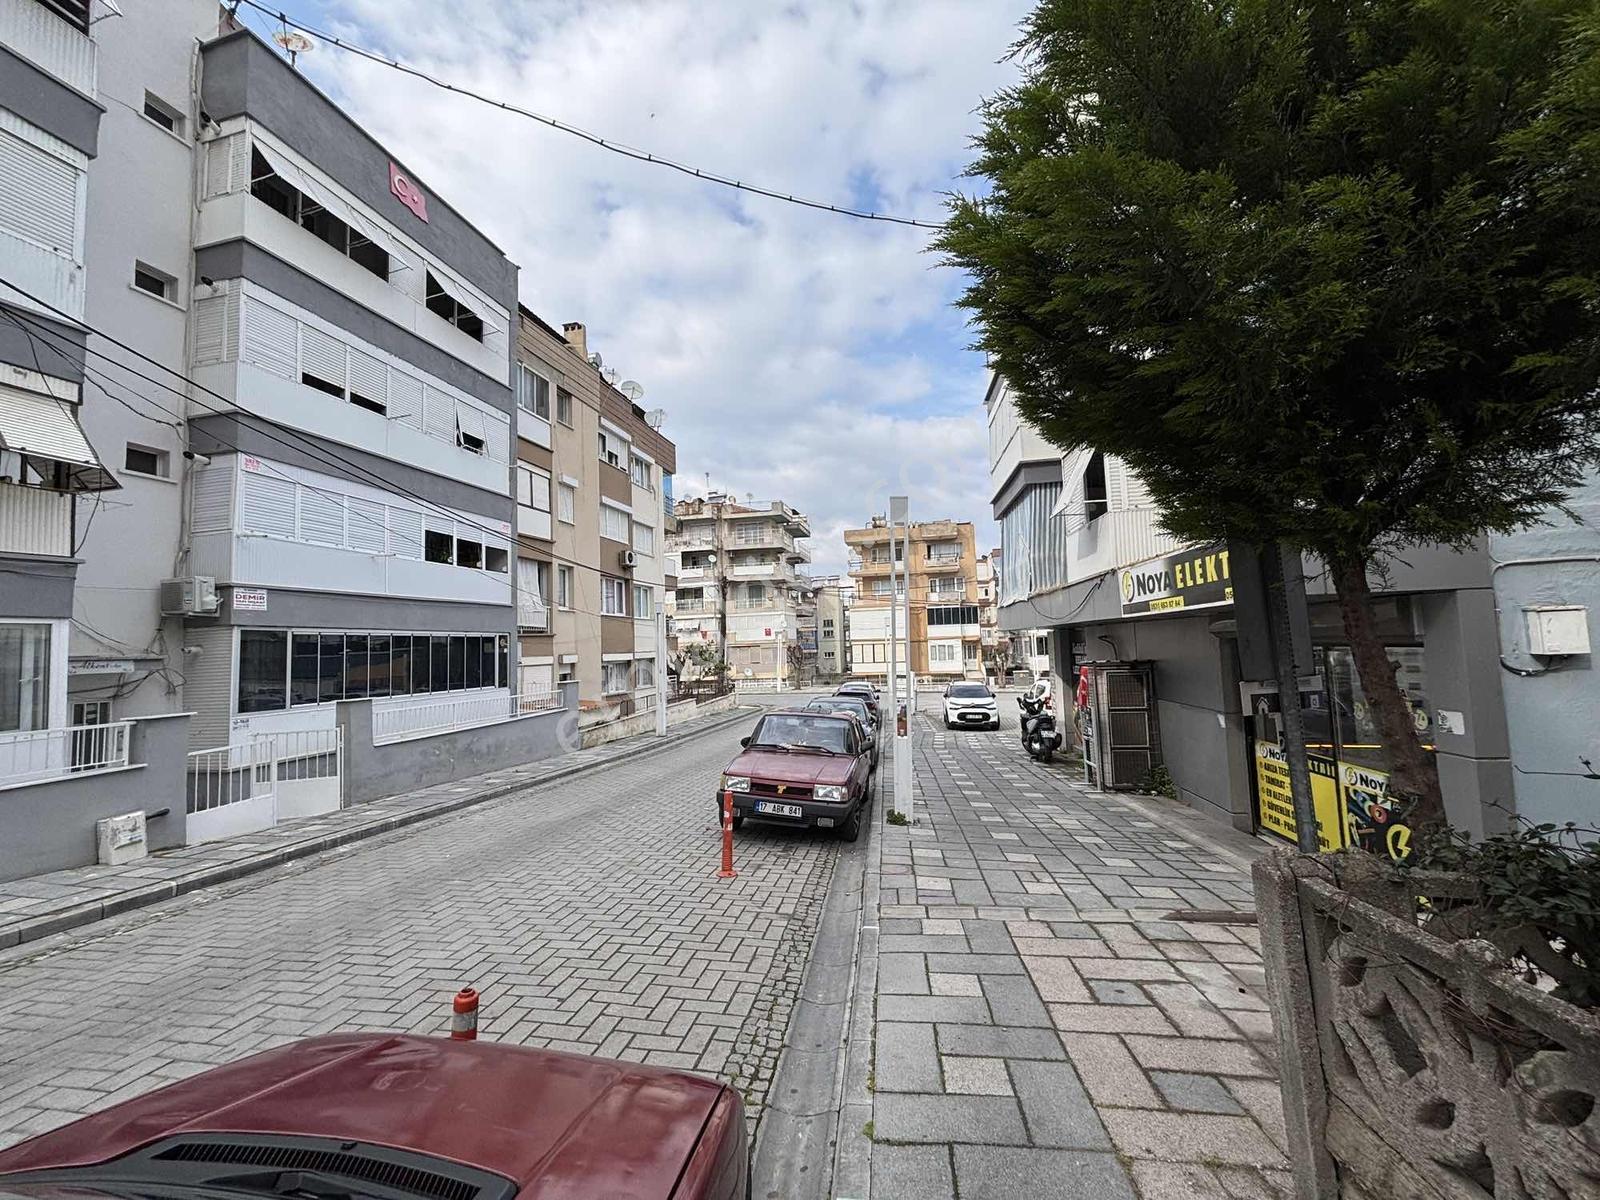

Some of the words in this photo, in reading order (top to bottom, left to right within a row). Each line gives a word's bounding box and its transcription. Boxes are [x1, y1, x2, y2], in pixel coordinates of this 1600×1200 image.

[1136, 571, 1171, 596] NOYA
[1175, 551, 1230, 589] ELEKT
[1269, 748, 1287, 762] NOY
[1359, 772, 1391, 795] NOYA
[760, 803, 767, 811] 17
[772, 804, 785, 814] ABK
[789, 806, 801, 816] 841
